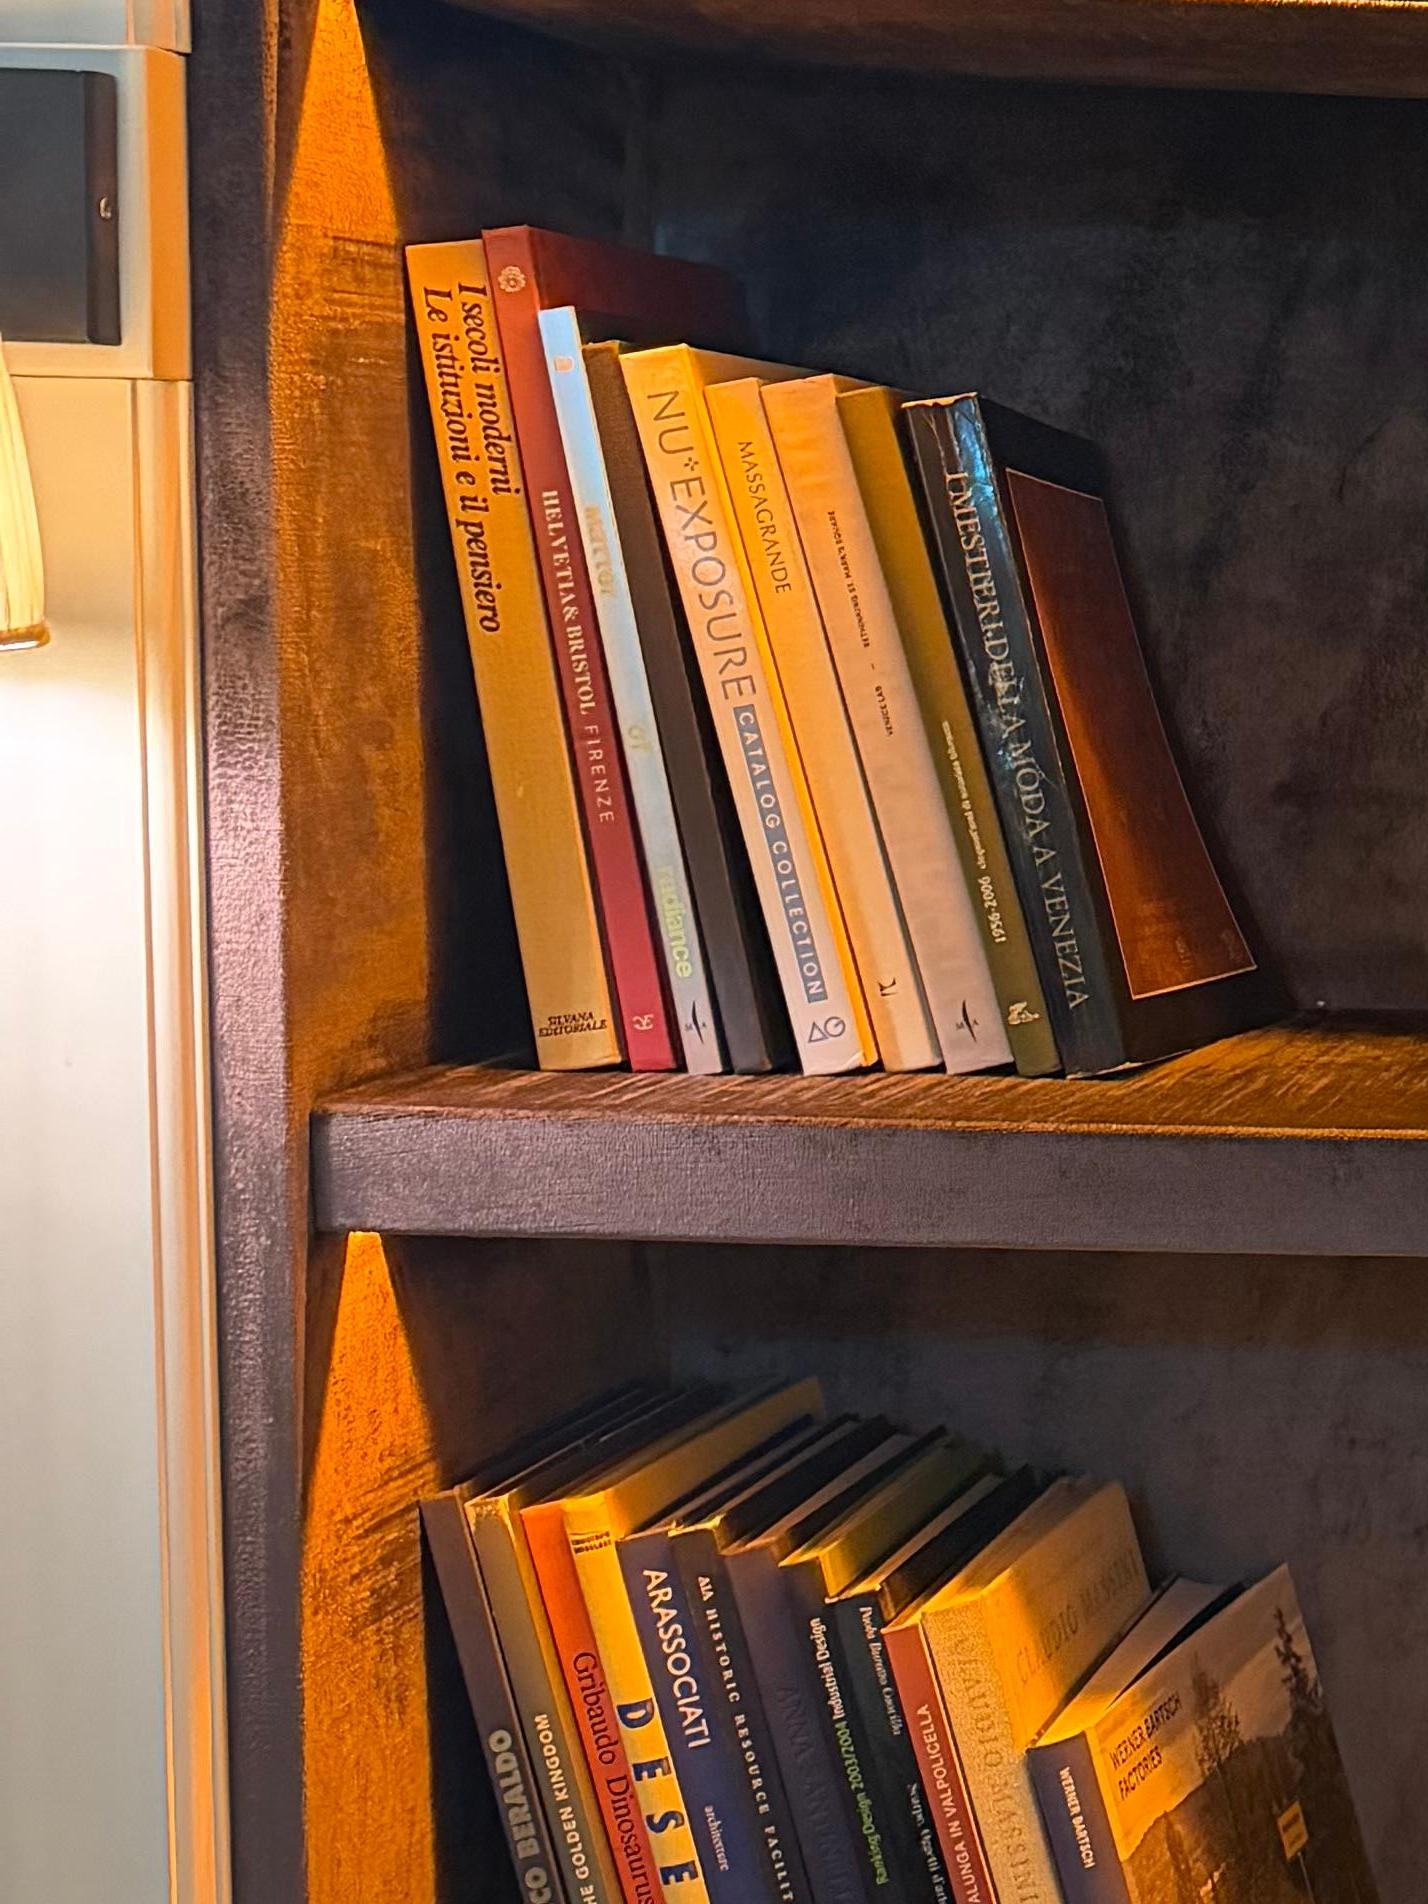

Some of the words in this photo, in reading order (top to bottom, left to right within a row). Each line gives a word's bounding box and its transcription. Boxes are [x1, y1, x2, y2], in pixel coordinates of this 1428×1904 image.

[423, 285, 454, 323] Le
[458, 283, 488, 297] I
[461, 300, 502, 374] secoli
[431, 331, 481, 464] istituzioni
[646, 390, 694, 455] NU
[455, 468, 477, 487] e
[474, 382, 521, 498] moderni
[459, 495, 490, 517] il
[737, 441, 793, 595] MASSAGRANDE
[456, 512, 502, 635] pensiero
[669, 475, 758, 702] EXPOSURE
[584, 724, 615, 824] FIRENZE
[1007, 739, 1051, 839] MODA
[737, 710, 781, 830] CATALOG
[772, 841, 826, 997] COLLECTION
[1032, 845, 1057, 867] A
[1039, 873, 1090, 1011] VENEZIA
[547, 1011, 595, 1026] SILVANA
[642, 1568, 711, 1750] ARASSOCIATI
[809, 1617, 832, 1660] Design
[572, 1650, 619, 1767] Gribaudo
[705, 1608, 741, 1704] HISTORIC
[733, 1713, 771, 1815] RESOURCE
[817, 1660, 846, 1720] Industrial
[533, 1713, 571, 1801] KINGDOM
[916, 1703, 960, 1820] VALPOLICELLA
[1108, 1727, 1148, 1772] WERNER
[1142, 1693, 1184, 1739] BARTSCH
[488, 1729, 541, 1860] BERALDO
[1058, 1765, 1083, 1822] WERNER
[1116, 1746, 1164, 1801] FACTORIES
[559, 1806, 592, 1881] GOLDEN
[946, 1821, 962, 1841] IN
[1070, 1818, 1098, 1870] BARTSCH
